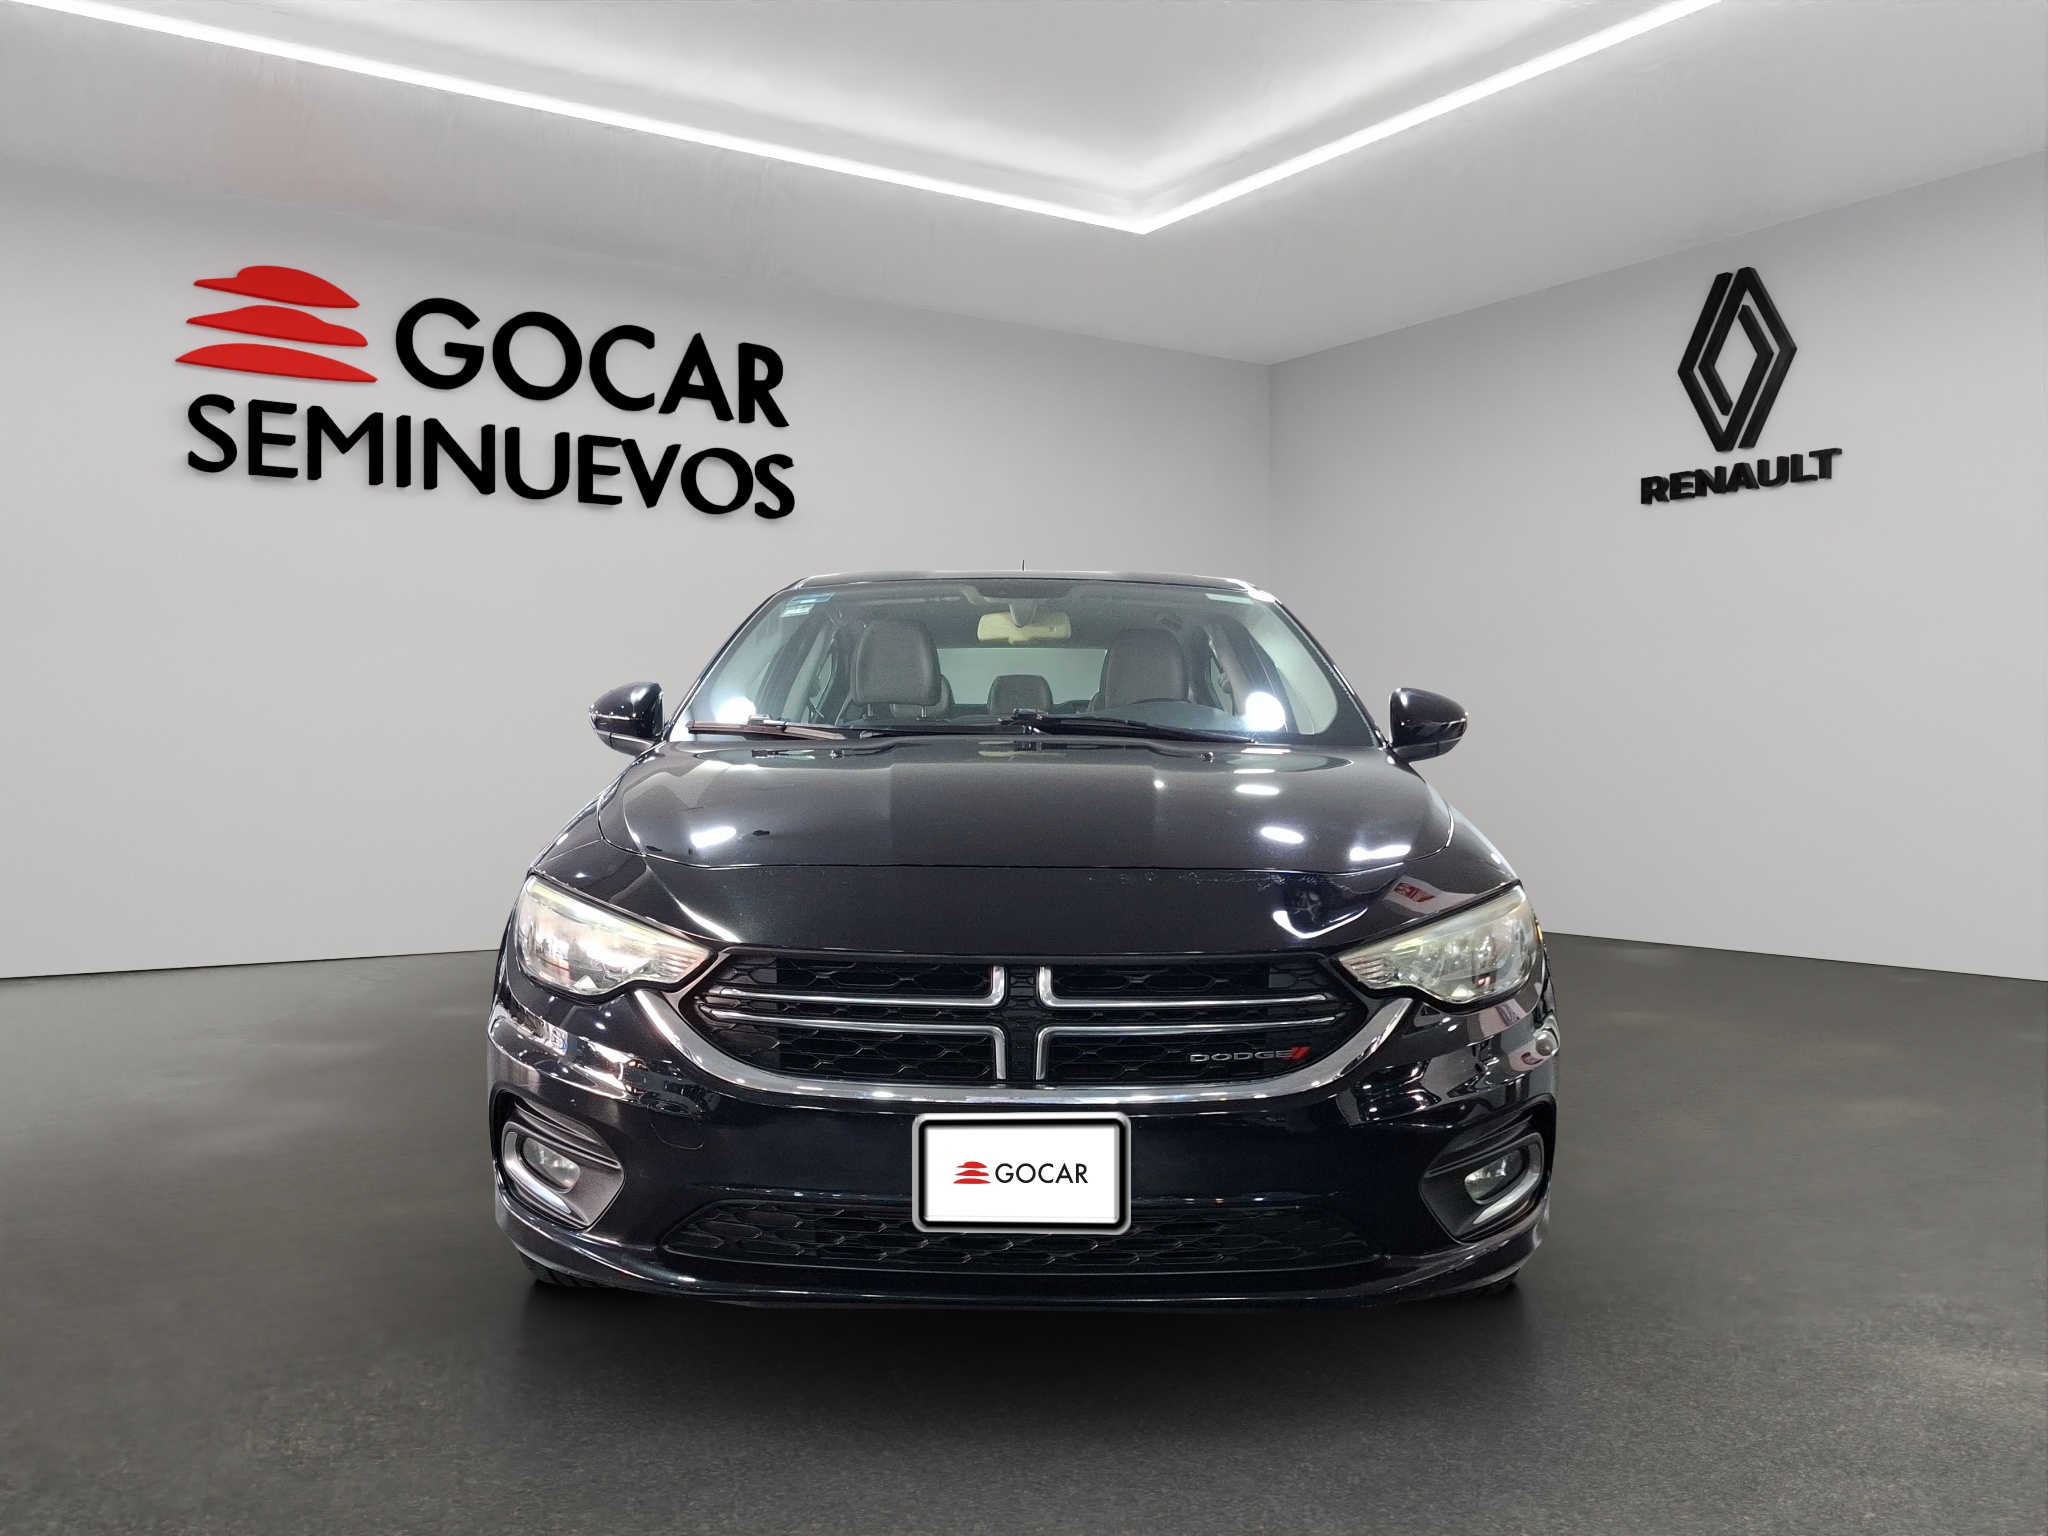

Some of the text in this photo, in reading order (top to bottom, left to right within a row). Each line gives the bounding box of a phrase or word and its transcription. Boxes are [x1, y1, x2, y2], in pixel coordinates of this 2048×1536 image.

[395, 297, 790, 428] GOCAR
[187, 393, 795, 520] SEMINUEVOS
[1640, 447, 1843, 505] RENAULT
[1189, 1050, 1294, 1063] DODGE
[994, 1162, 1089, 1184] GOCAR
